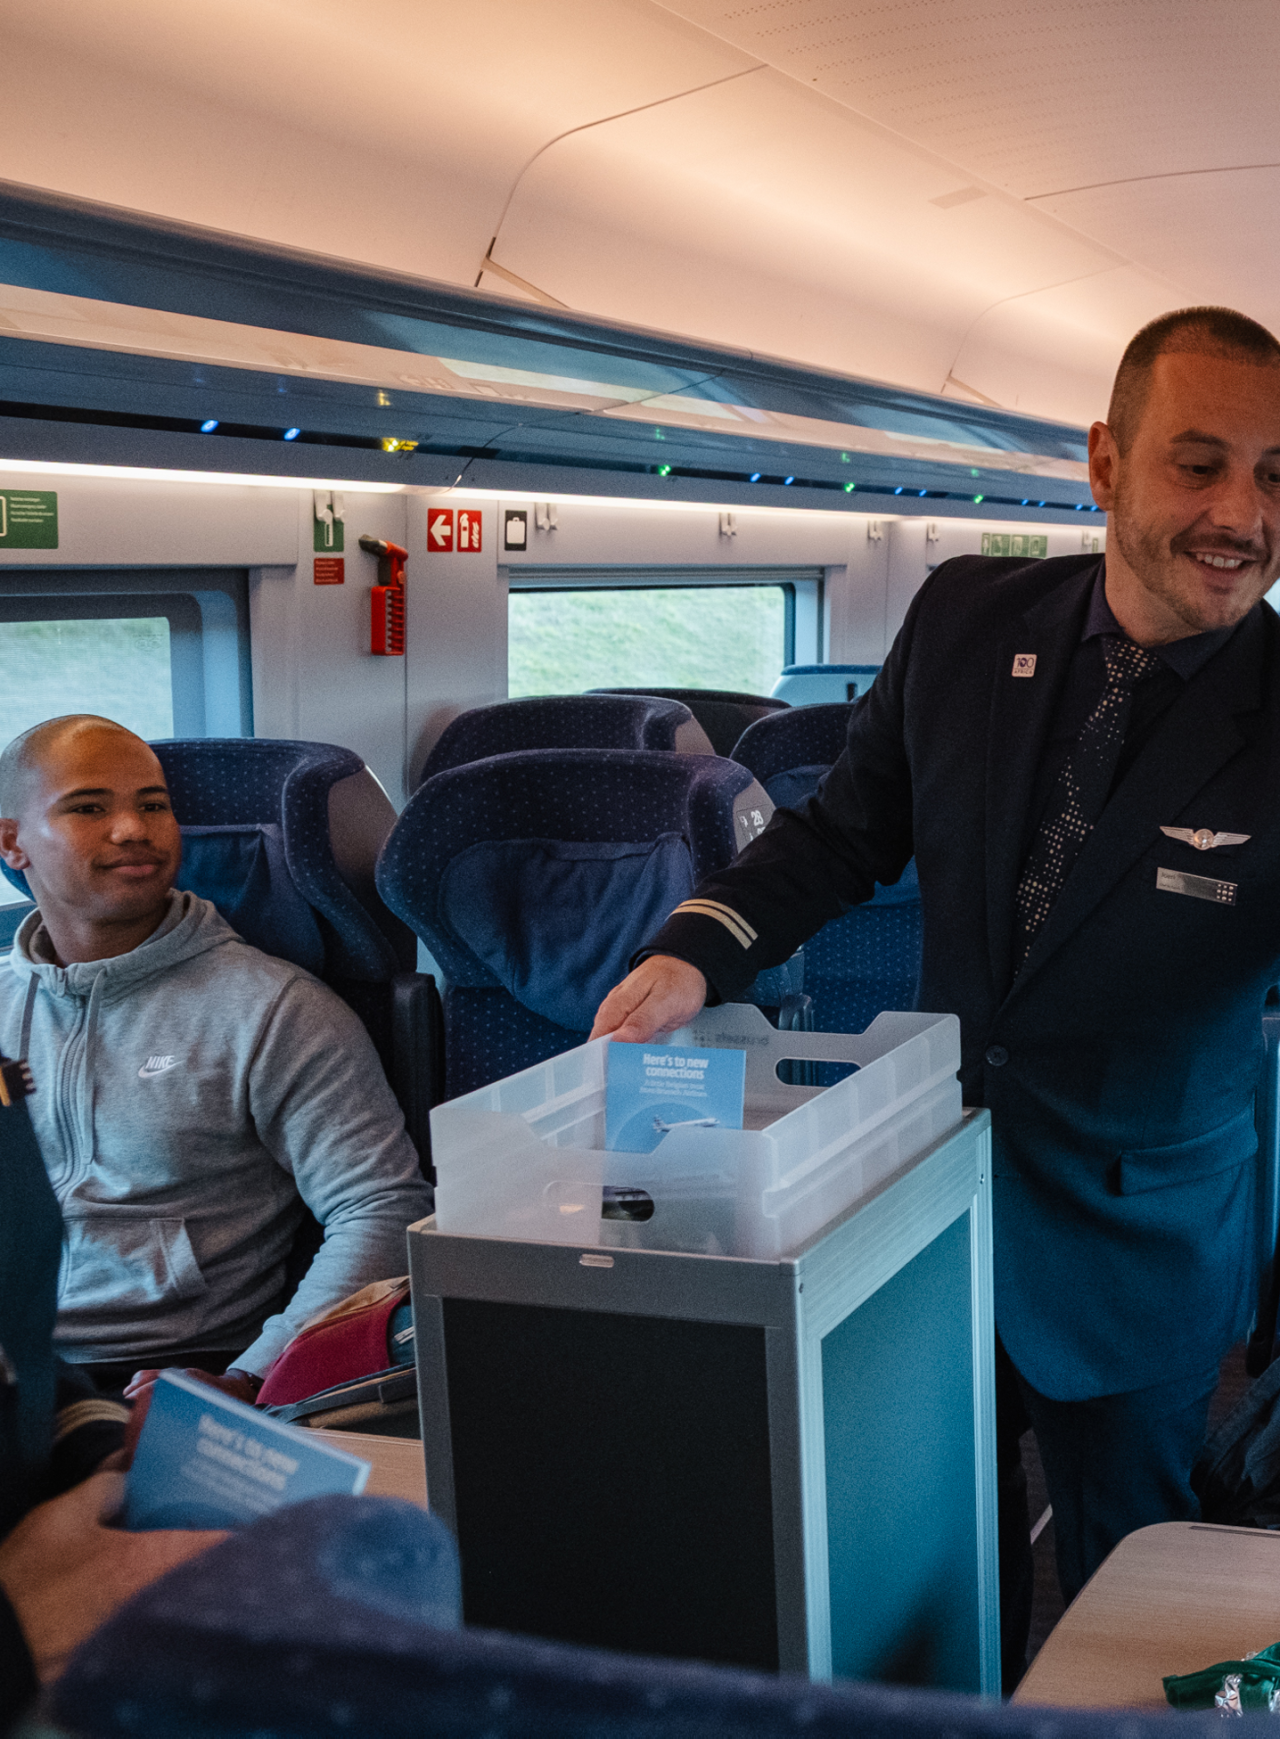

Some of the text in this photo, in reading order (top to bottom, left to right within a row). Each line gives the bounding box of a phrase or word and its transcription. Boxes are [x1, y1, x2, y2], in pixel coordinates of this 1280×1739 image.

[750, 809, 764, 827] 28
[145, 1055, 175, 1069] NIKE
[643, 1053, 709, 1069] Here's to new
[645, 1066, 705, 1080] connections
